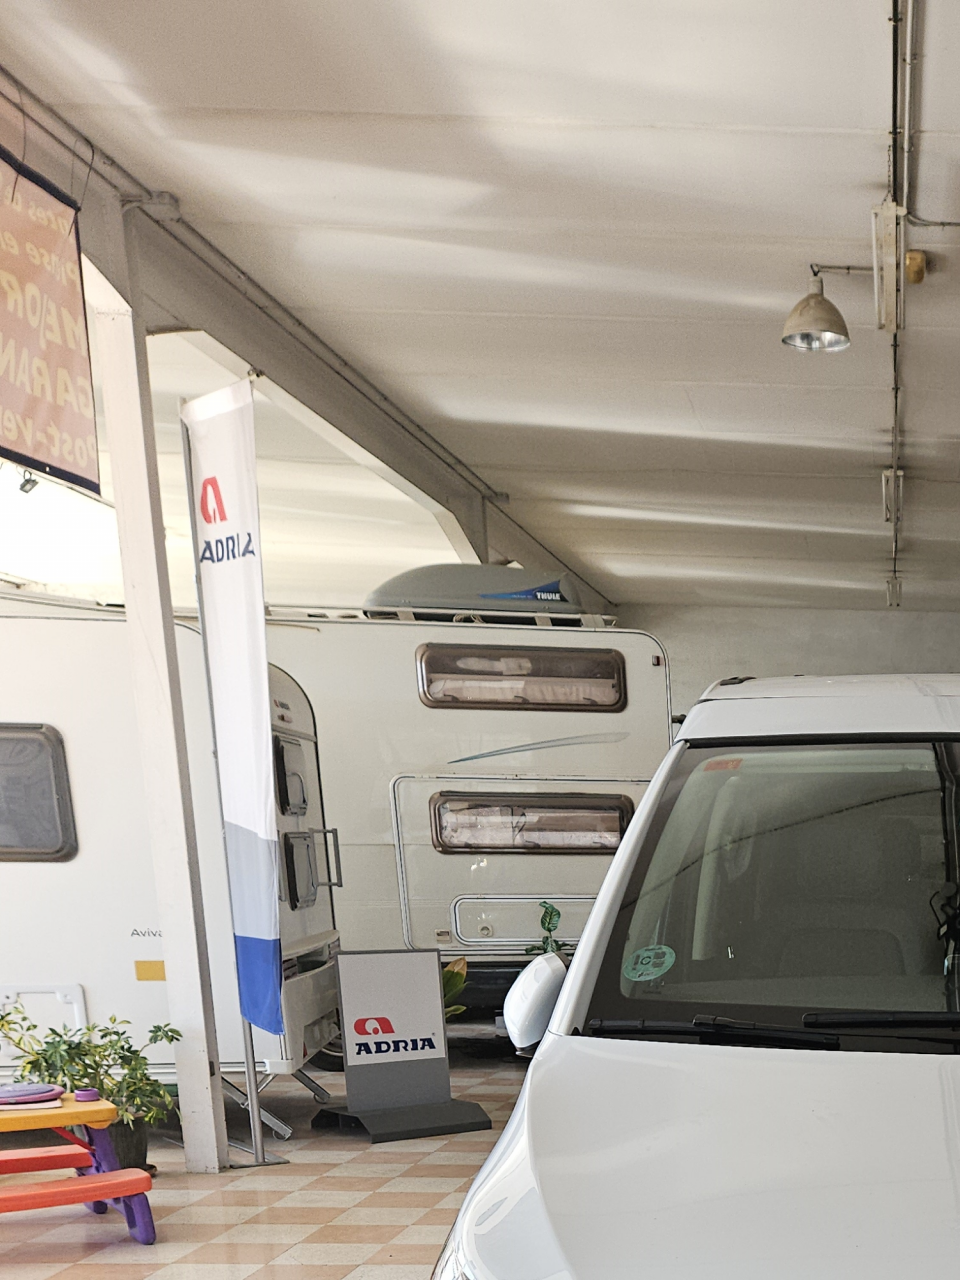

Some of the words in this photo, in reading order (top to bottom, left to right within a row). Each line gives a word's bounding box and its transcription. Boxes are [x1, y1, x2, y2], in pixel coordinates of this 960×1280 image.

[200, 532, 256, 564] ADRIA
[535, 592, 561, 600] THULE
[355, 1037, 436, 1055] ADRIA
